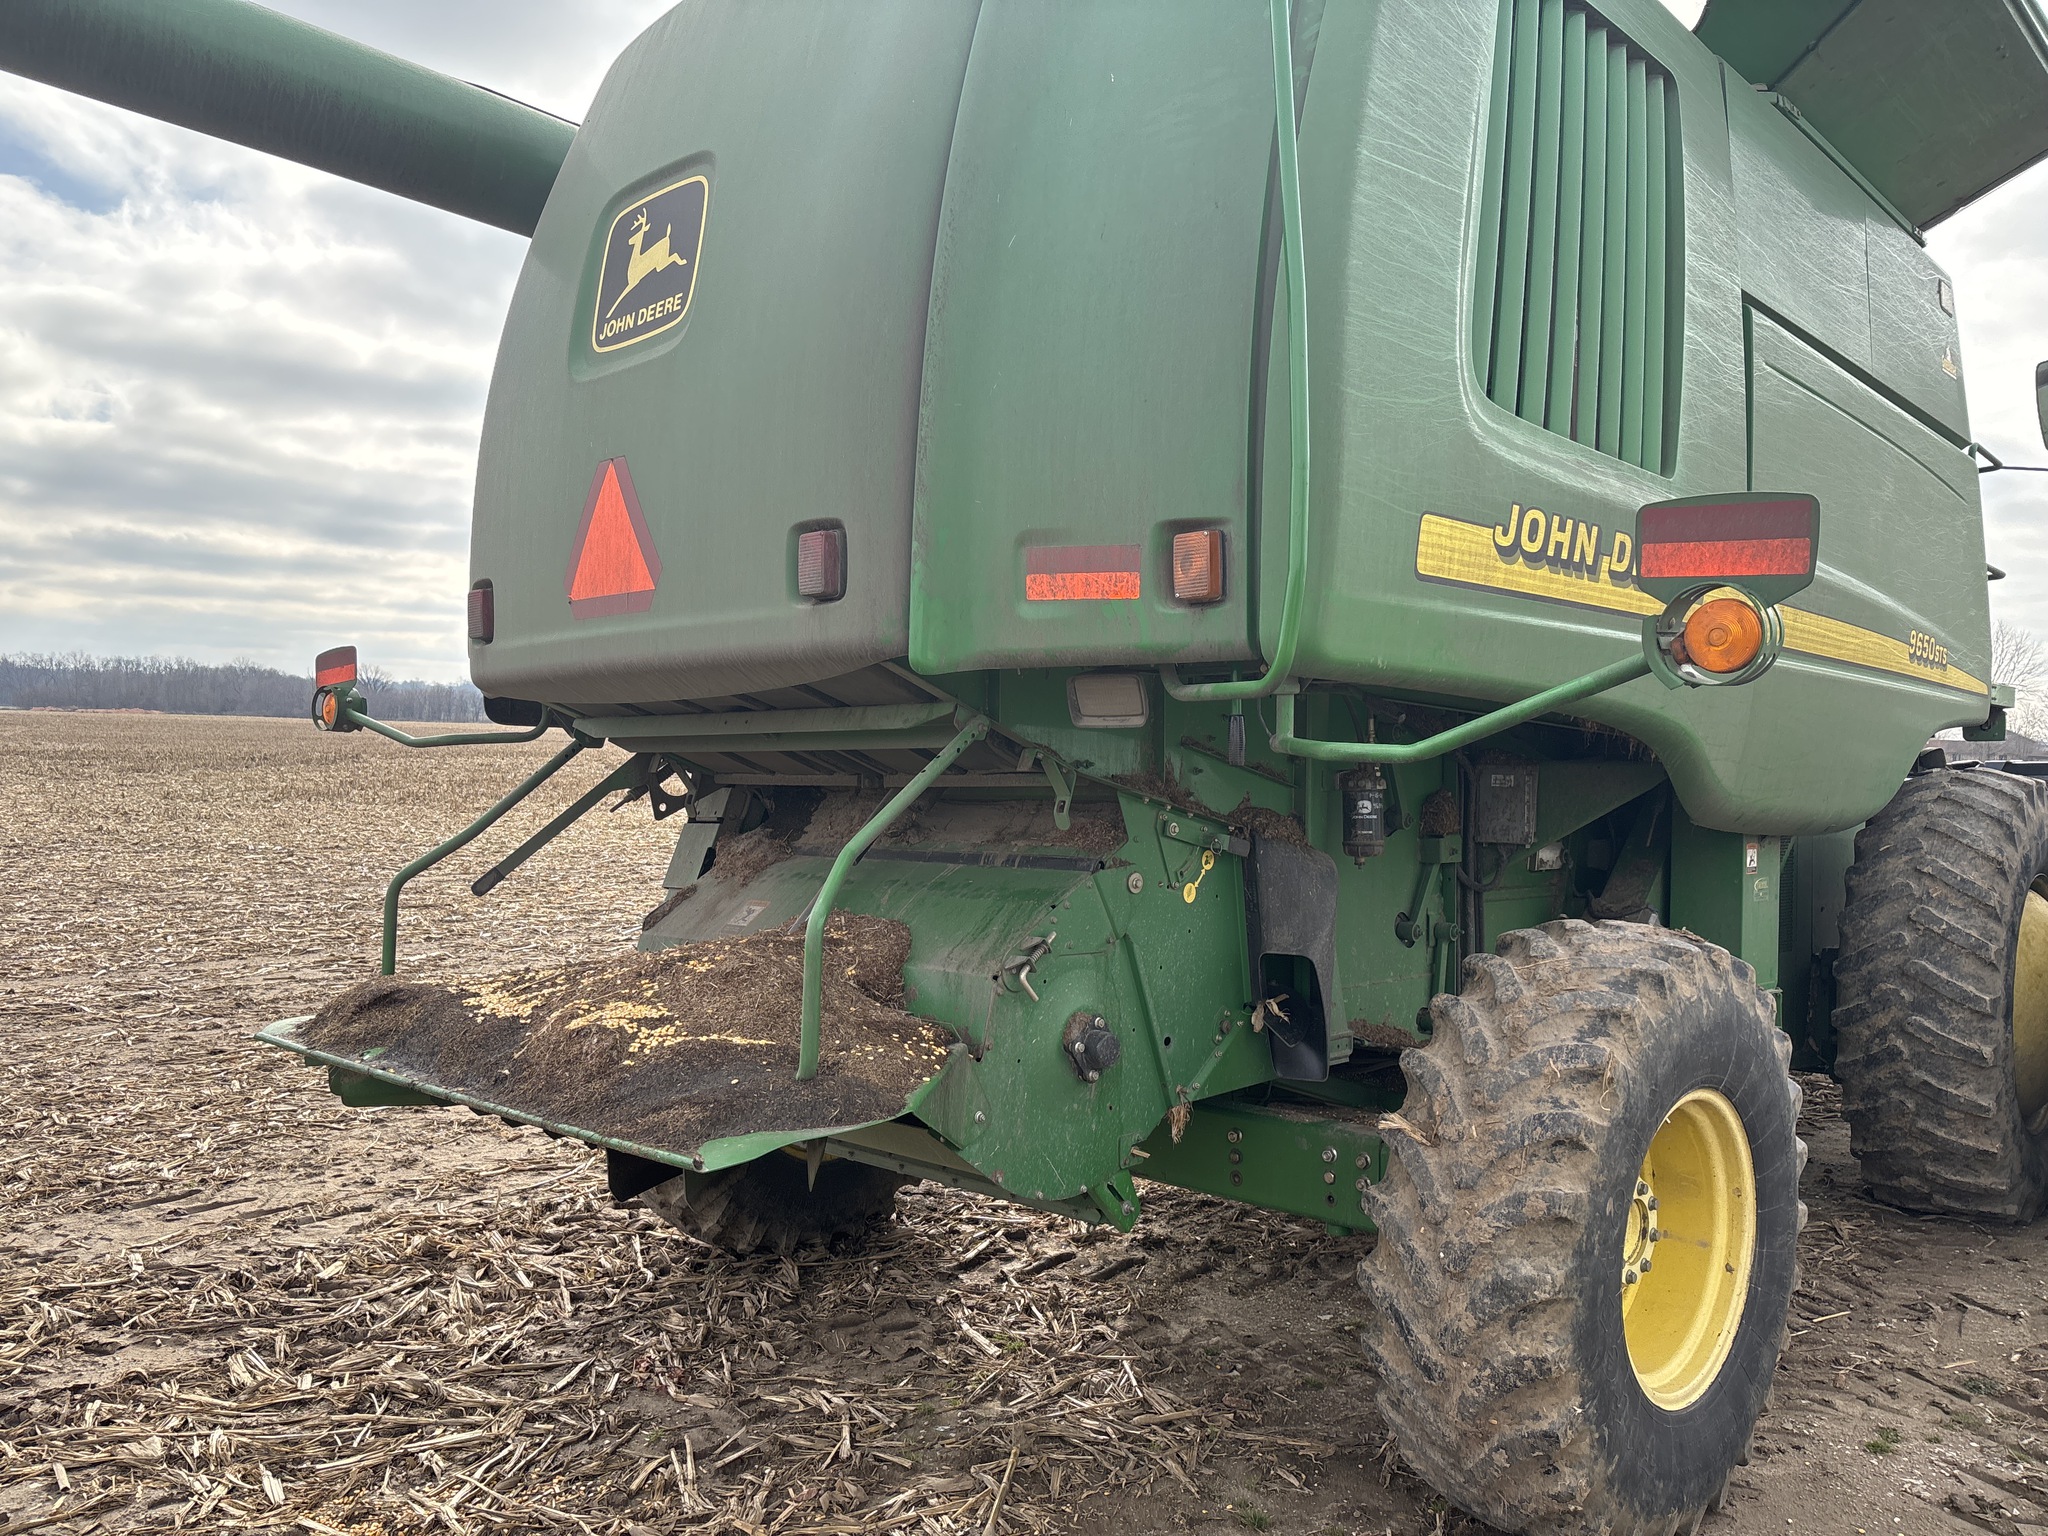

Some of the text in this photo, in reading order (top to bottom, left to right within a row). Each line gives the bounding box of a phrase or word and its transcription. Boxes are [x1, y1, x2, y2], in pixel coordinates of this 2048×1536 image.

[599, 293, 683, 340] JOHN DEERE
[1494, 503, 1600, 570] JOHN
